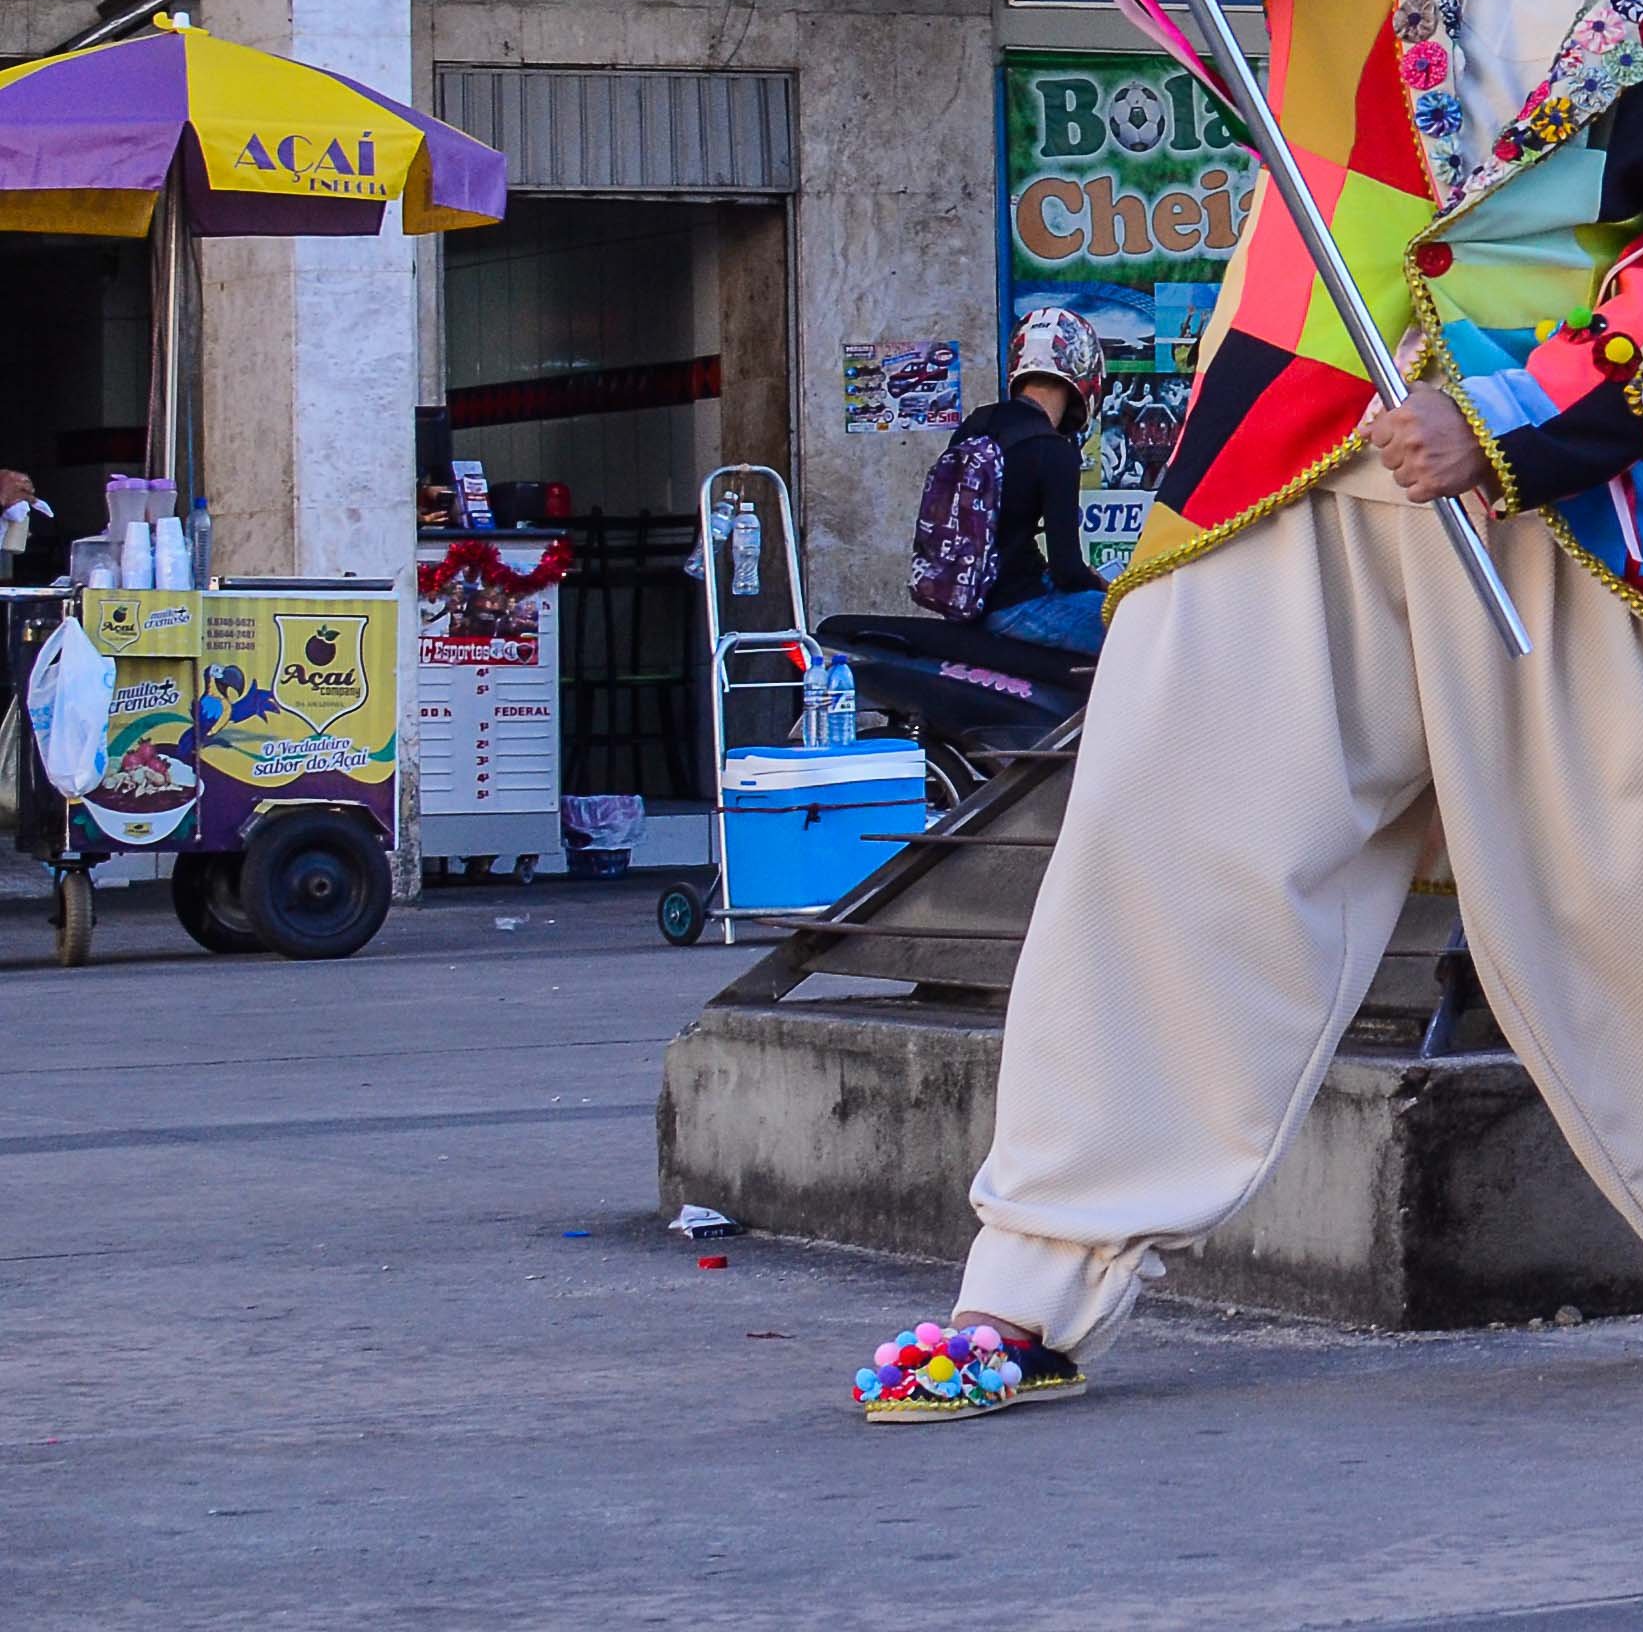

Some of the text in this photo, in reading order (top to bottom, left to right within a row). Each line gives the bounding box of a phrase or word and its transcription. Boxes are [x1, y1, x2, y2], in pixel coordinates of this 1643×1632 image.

[234, 131, 375, 183] AÇAÍ
[434, 641, 491, 663] Esportes
[494, 706, 551, 717] FEDERAL
[254, 757, 302, 776] sabor
